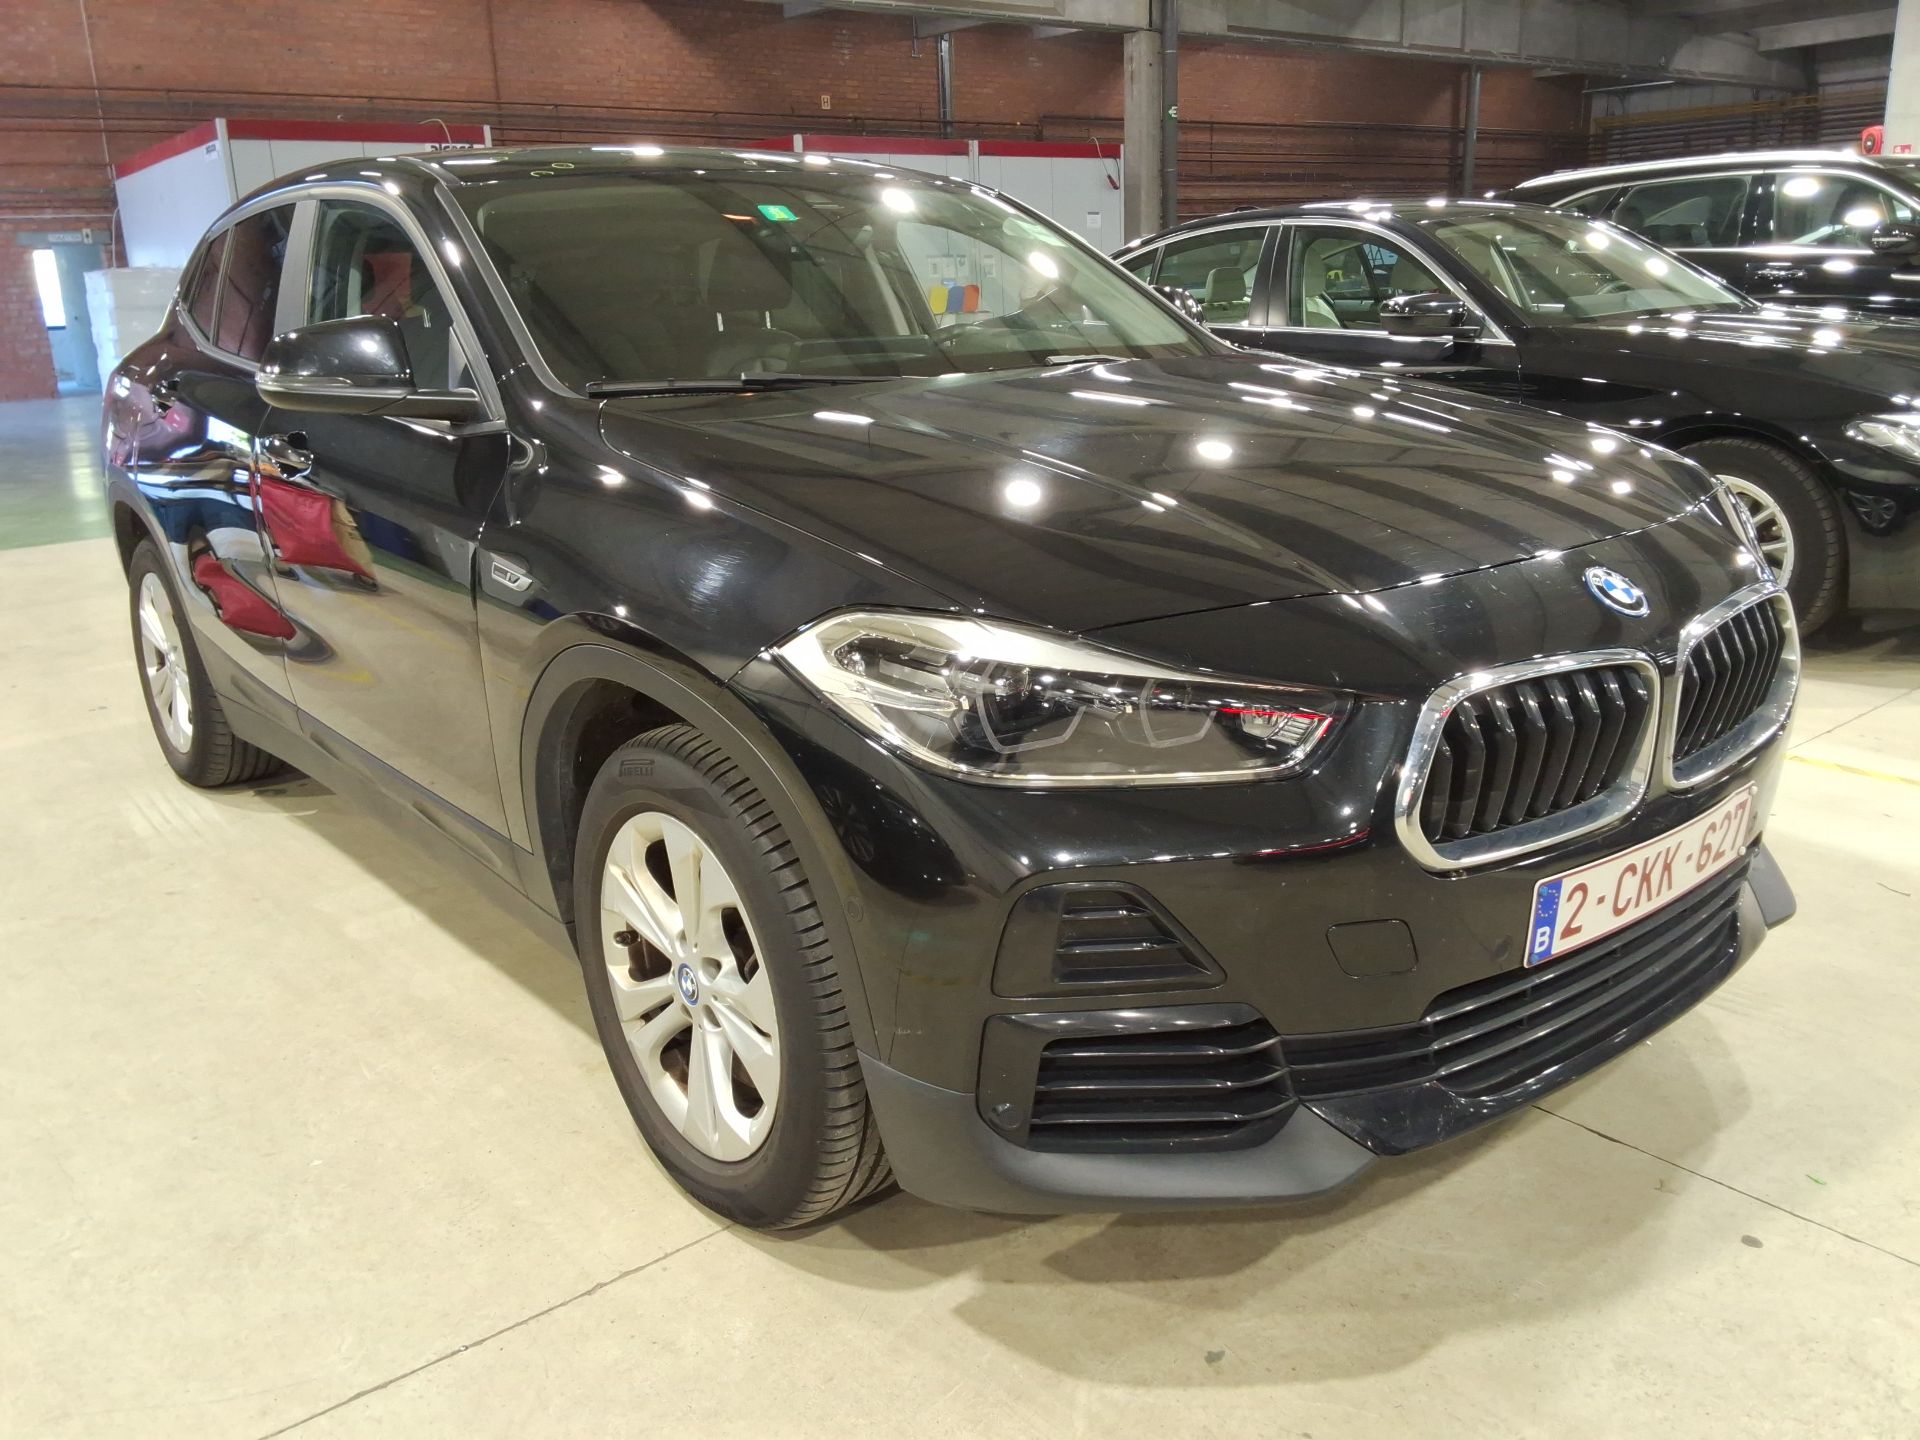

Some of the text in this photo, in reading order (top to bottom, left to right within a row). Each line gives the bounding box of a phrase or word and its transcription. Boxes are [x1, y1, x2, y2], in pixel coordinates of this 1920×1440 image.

[619, 759, 655, 777] PIRELLI
[1560, 800, 1749, 940] 2-CKK-627
[1534, 926, 1551, 953] B
